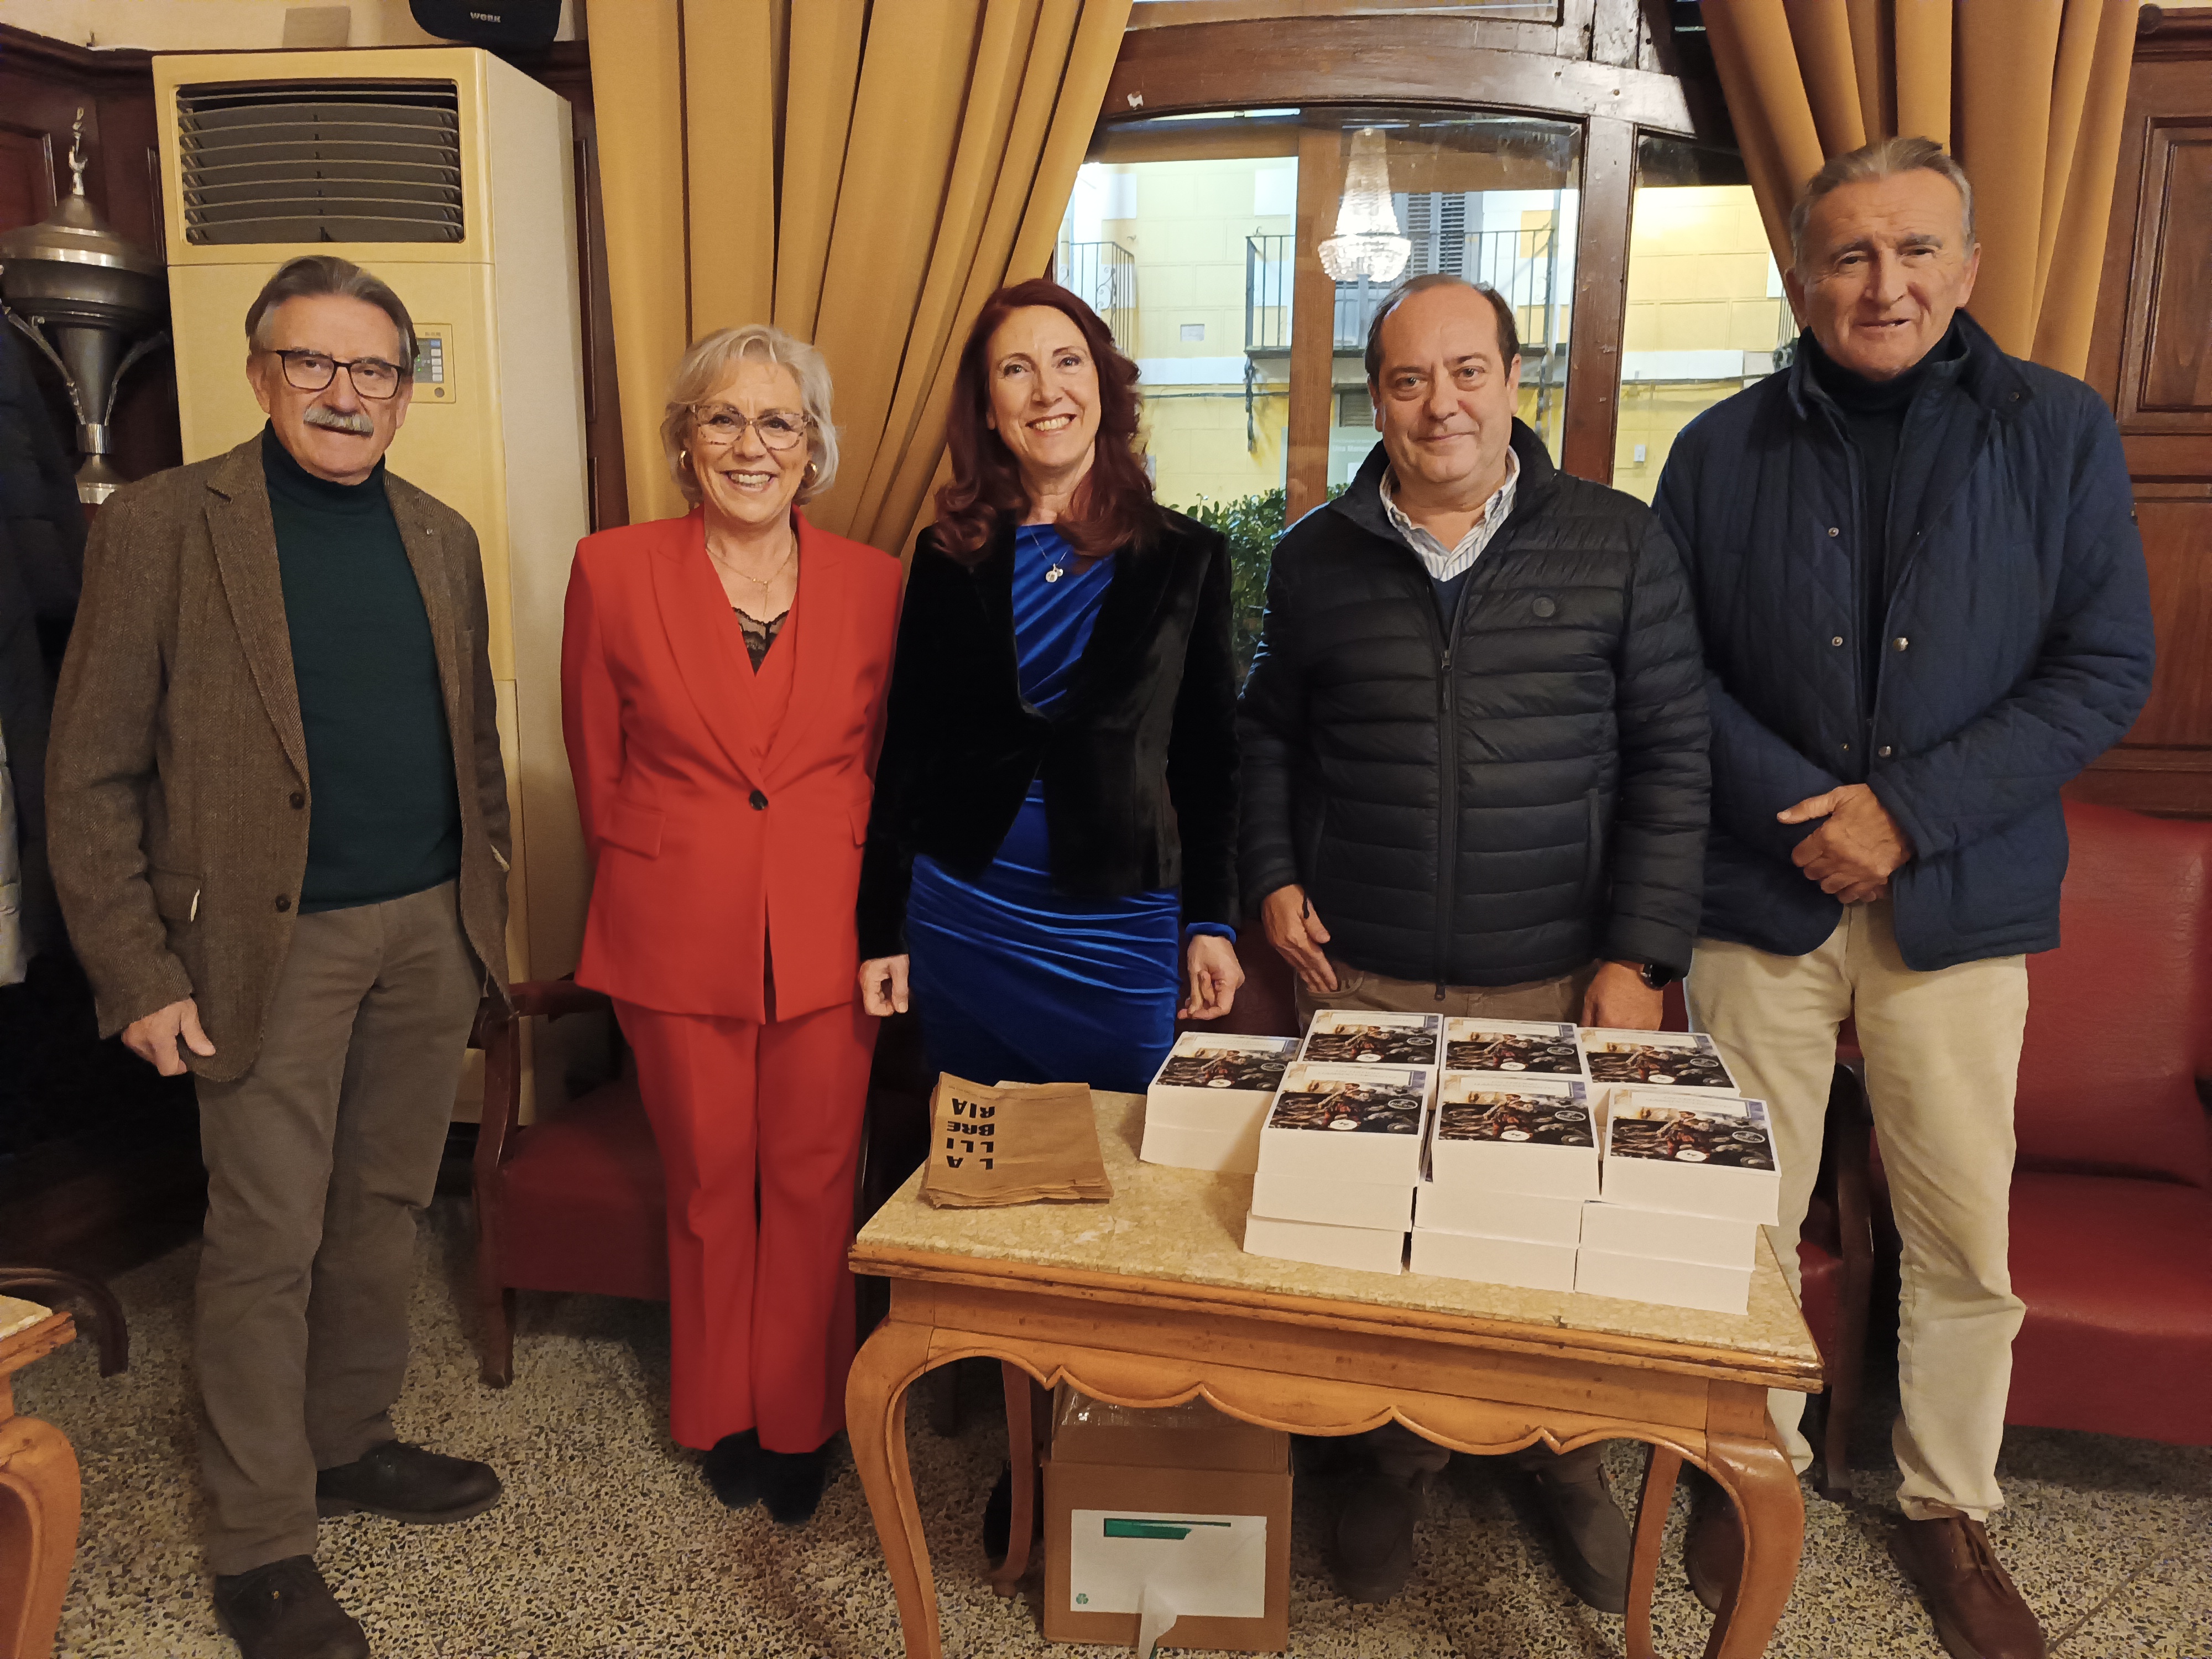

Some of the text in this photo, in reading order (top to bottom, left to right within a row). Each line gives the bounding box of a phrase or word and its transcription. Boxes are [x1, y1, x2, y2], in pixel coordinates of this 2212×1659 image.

[952, 1098, 995, 1119] RIA
[947, 1121, 995, 1136] BRE
[947, 1138, 994, 1153] LLI
